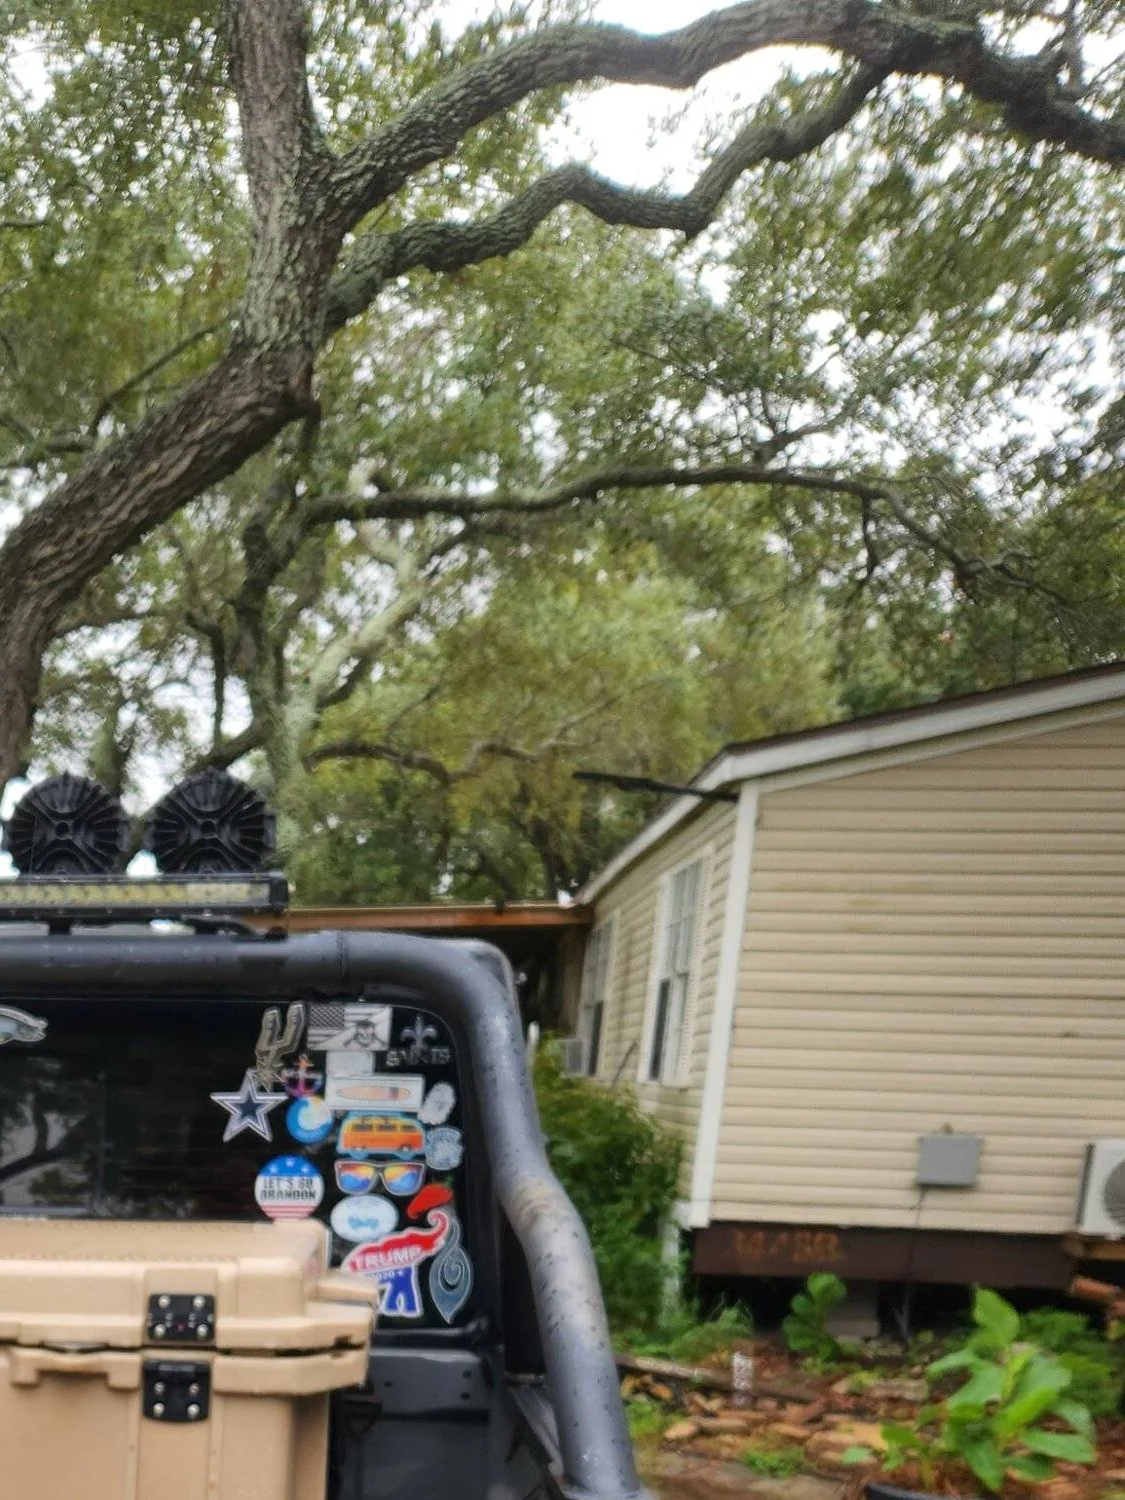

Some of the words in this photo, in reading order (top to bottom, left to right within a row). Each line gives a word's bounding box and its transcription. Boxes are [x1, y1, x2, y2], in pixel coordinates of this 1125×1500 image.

[263, 1176, 294, 1189] LET'S
[298, 1176, 313, 1190] GO
[260, 1188, 316, 1201] BRANDON
[356, 1244, 422, 1270] TRUMP
